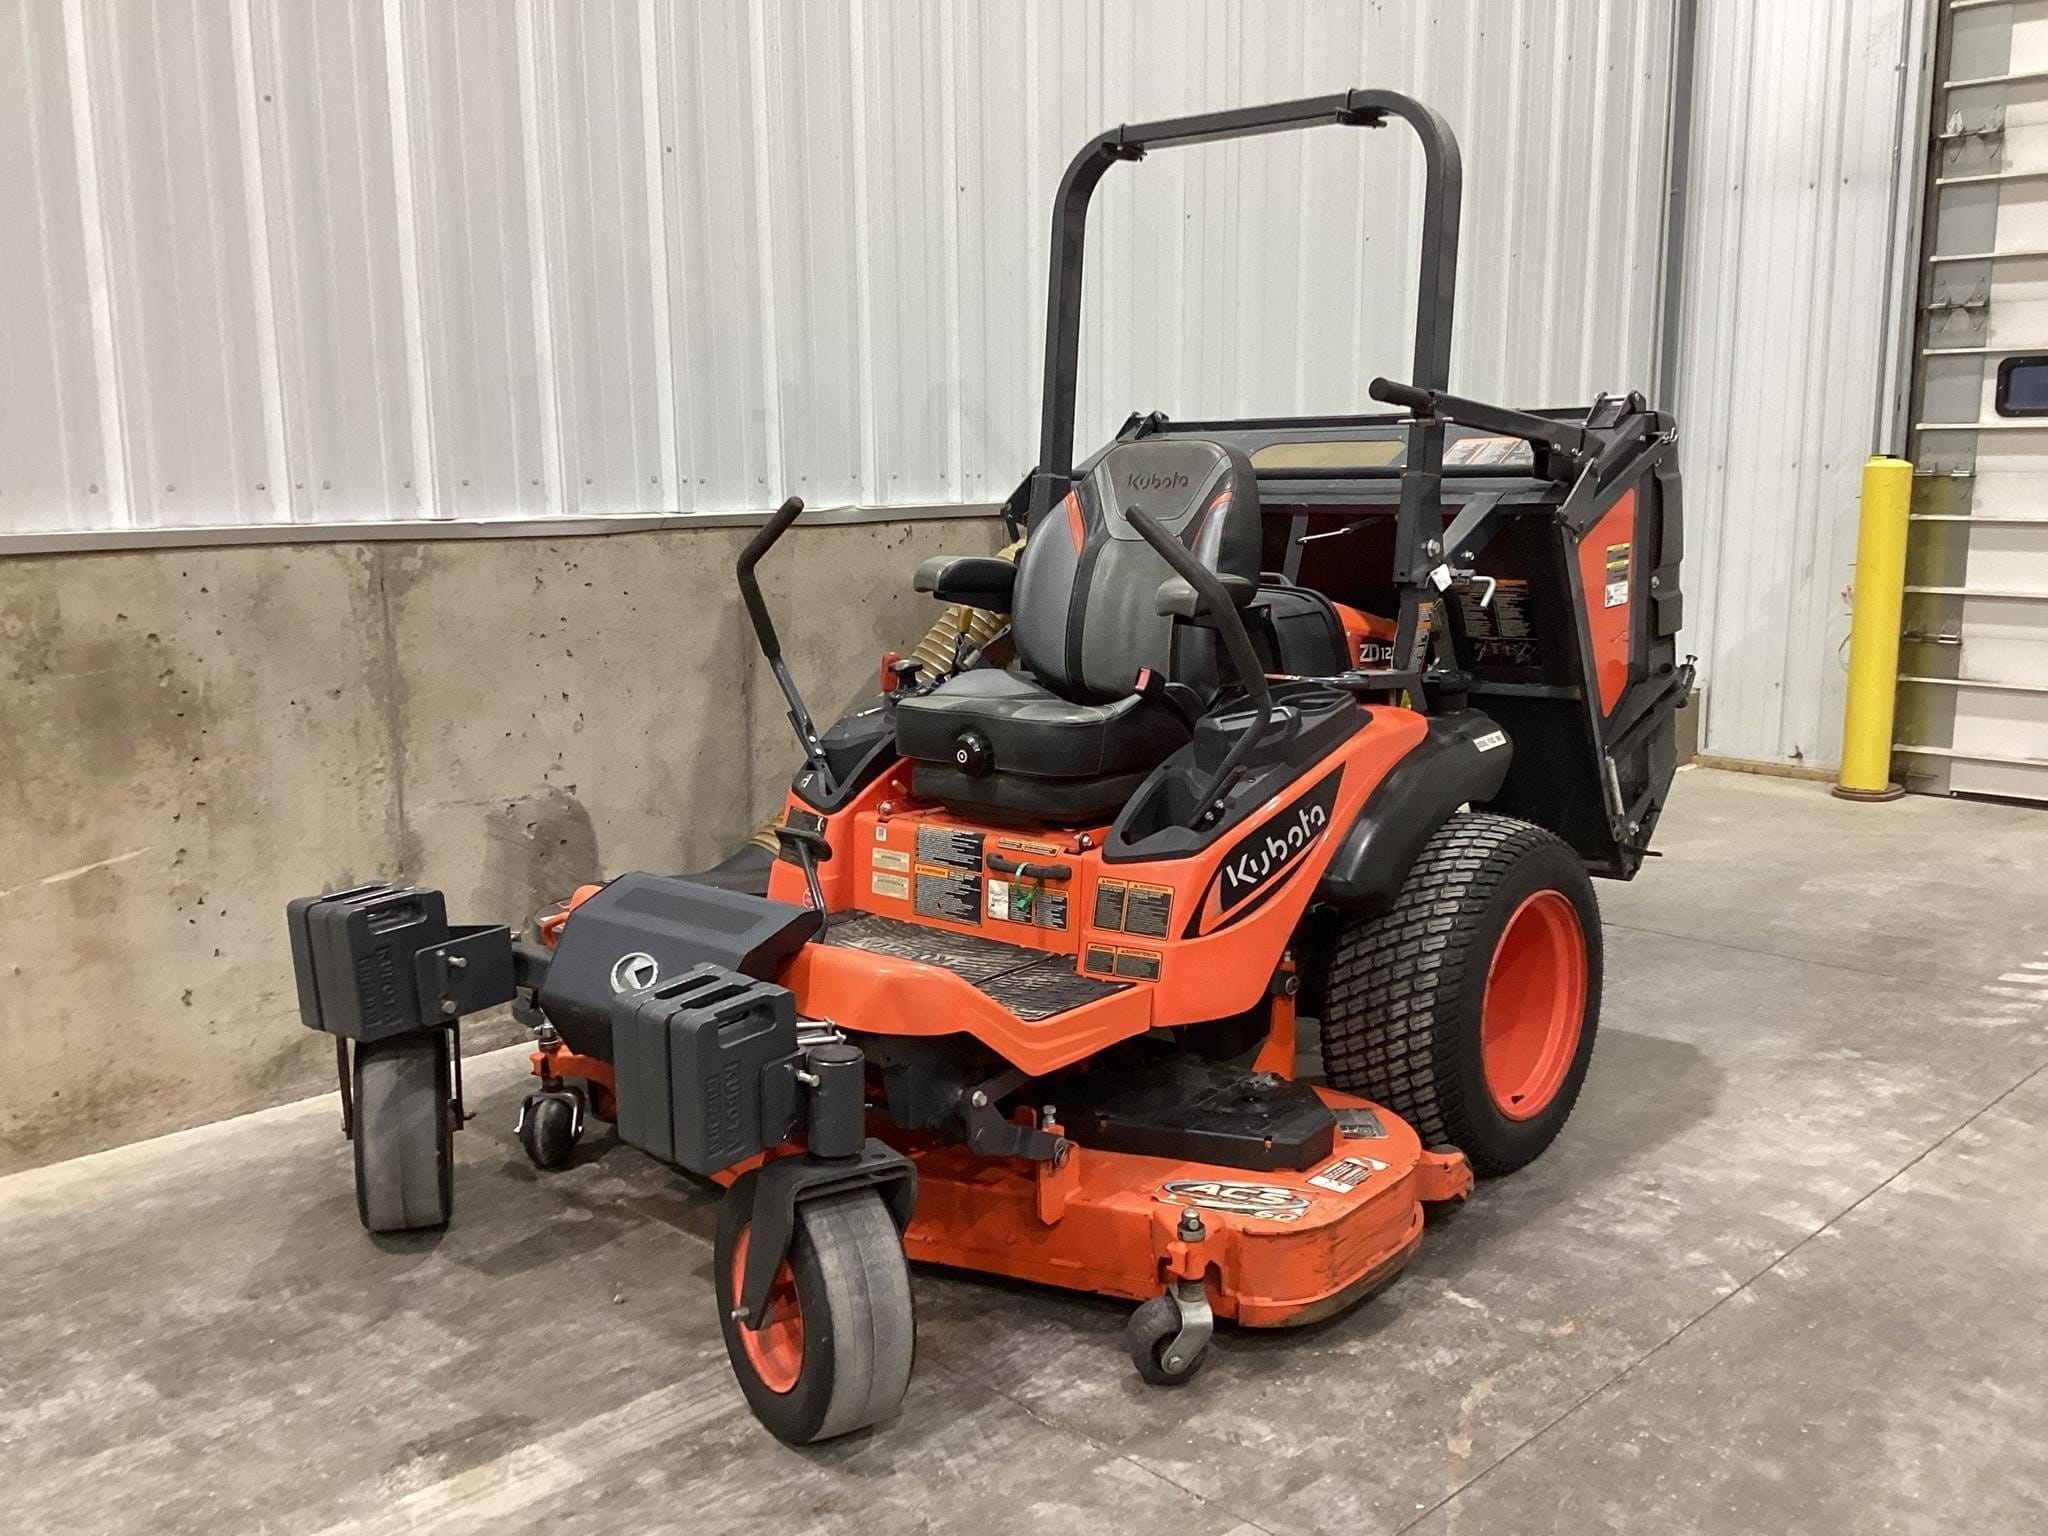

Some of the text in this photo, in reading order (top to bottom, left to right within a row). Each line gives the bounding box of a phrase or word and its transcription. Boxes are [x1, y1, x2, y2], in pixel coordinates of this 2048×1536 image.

[1127, 471, 1189, 490] Kubota
[1359, 643, 1394, 663] ZD12
[1225, 804, 1326, 888] Kubota
[1183, 1183, 1293, 1205] ACS
[1253, 1210, 1299, 1222] 60
